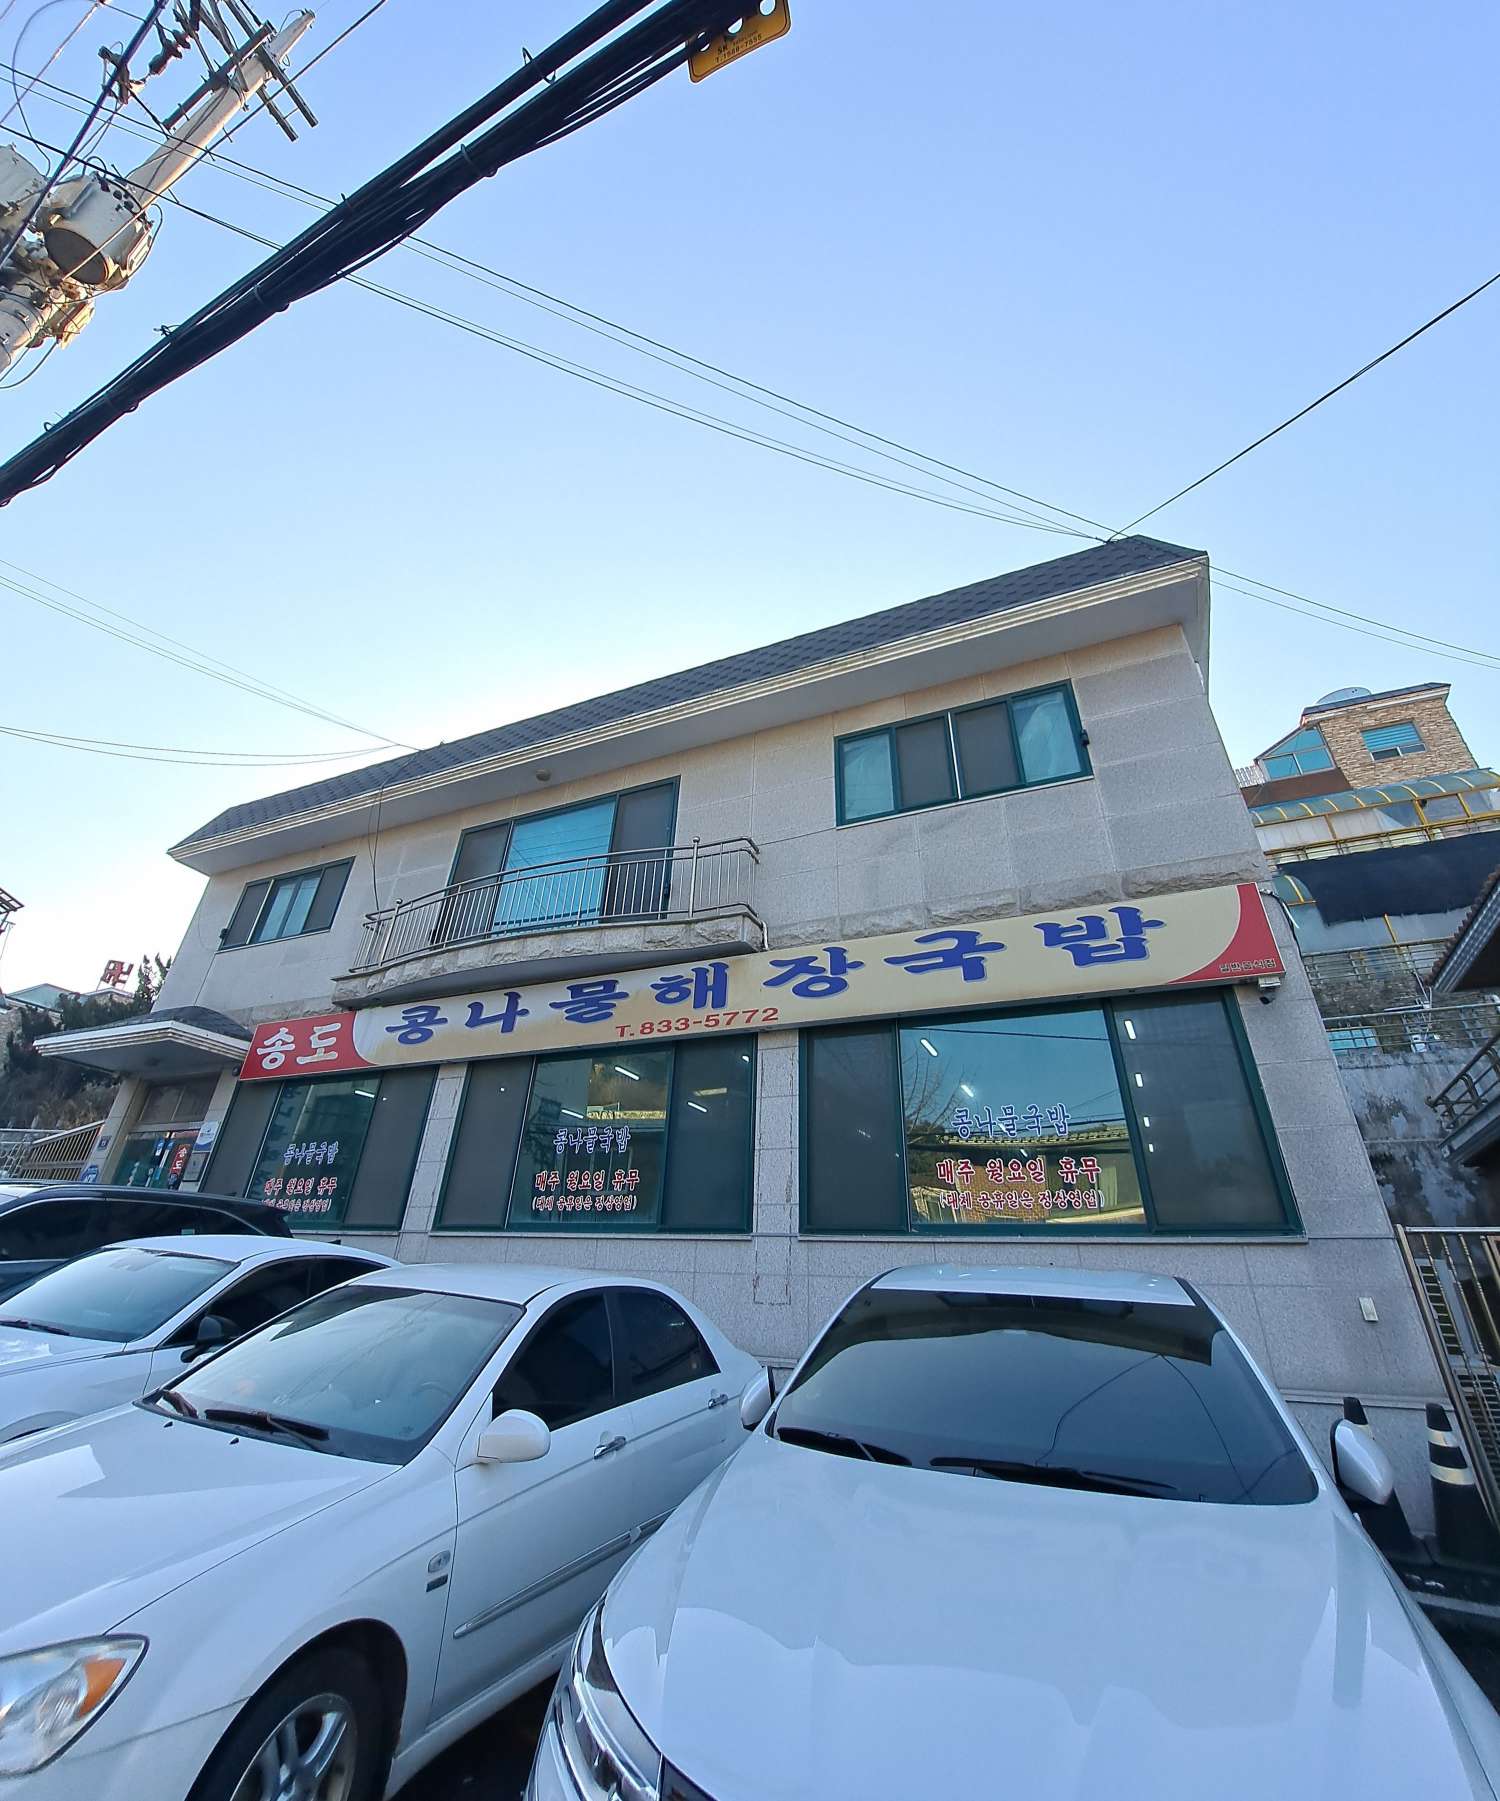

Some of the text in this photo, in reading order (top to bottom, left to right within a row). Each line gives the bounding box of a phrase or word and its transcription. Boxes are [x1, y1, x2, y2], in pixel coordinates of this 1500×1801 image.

[256, 906, 1168, 1070] 송도 콩나물해장국밥
[615, 1007, 779, 1039] T.833-5772
[951, 1103, 1071, 1138] 콩나물국밥
[553, 1125, 632, 1154] 콩나물국밥
[535, 1169, 640, 1191] 매주 월요일 휴무
[936, 1156, 1102, 1184] 매주 월요일 휴무
[557, 1195, 593, 1211] 공휴일은
[978, 1190, 1034, 1209] 공휴일은
[1038, 1189, 1105, 1209] 정상영업)
